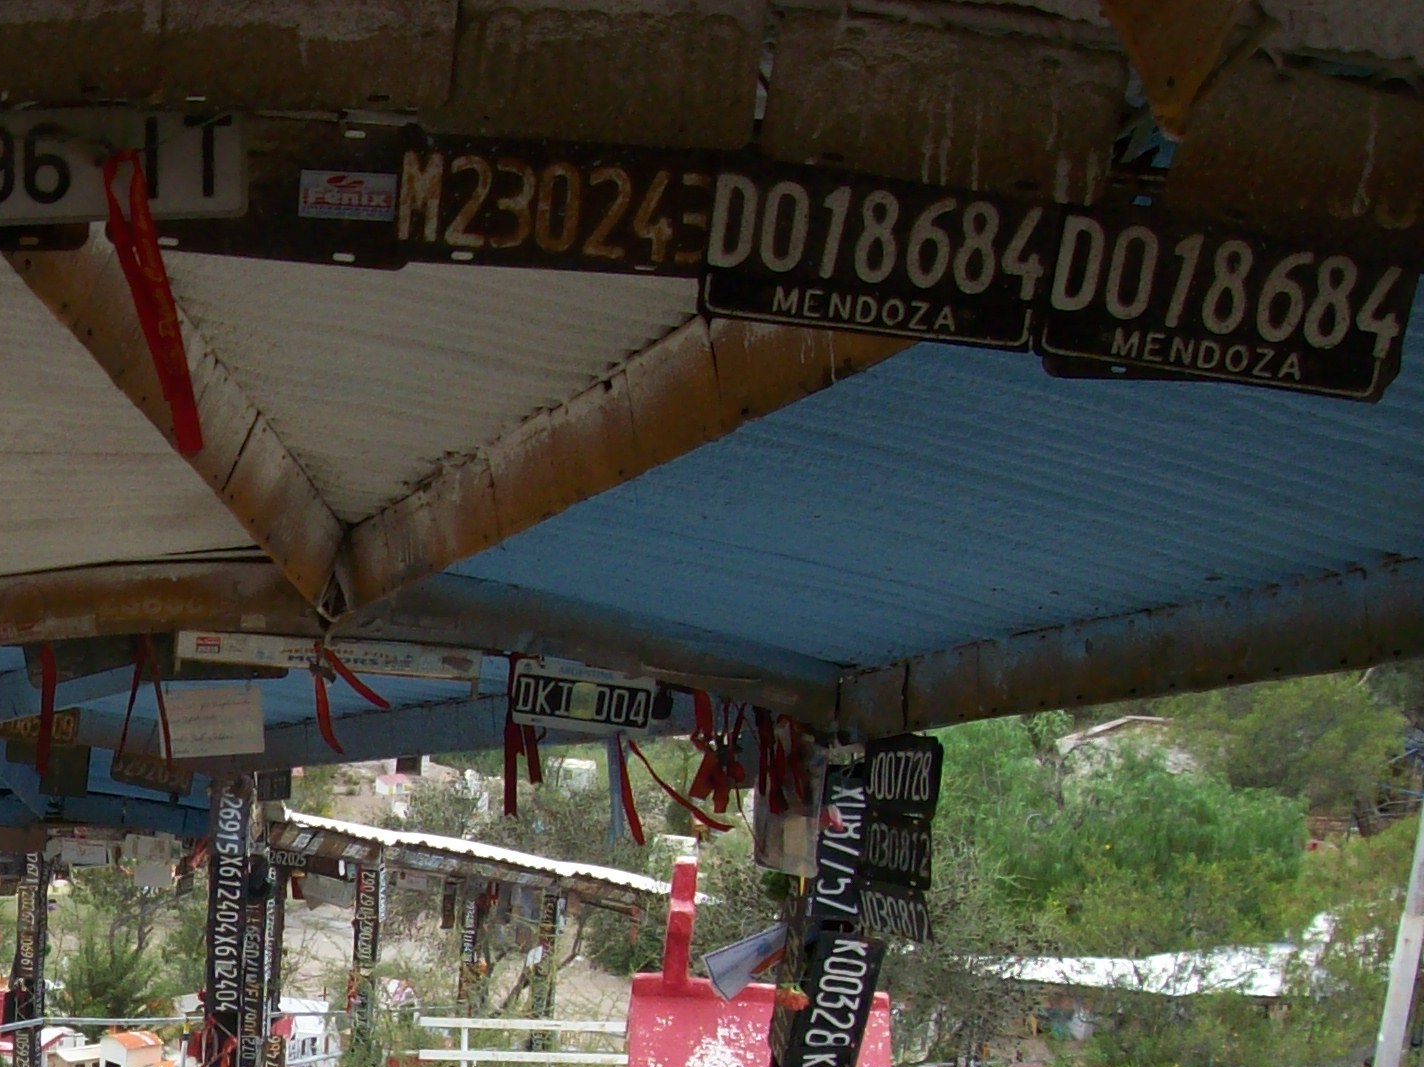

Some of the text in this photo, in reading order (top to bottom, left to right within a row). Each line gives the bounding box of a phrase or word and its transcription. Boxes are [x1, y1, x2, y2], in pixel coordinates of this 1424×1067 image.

[707, 172, 1045, 302] D018684
[771, 284, 958, 334] MENDOZA
[1050, 212, 1405, 359] D018684
[1110, 323, 1304, 382] MENDOZA
[516, 677, 647, 726] DKI 004
[865, 750, 932, 801] J007728
[215, 857, 244, 934] X612404
[213, 936, 239, 1012] X612404
